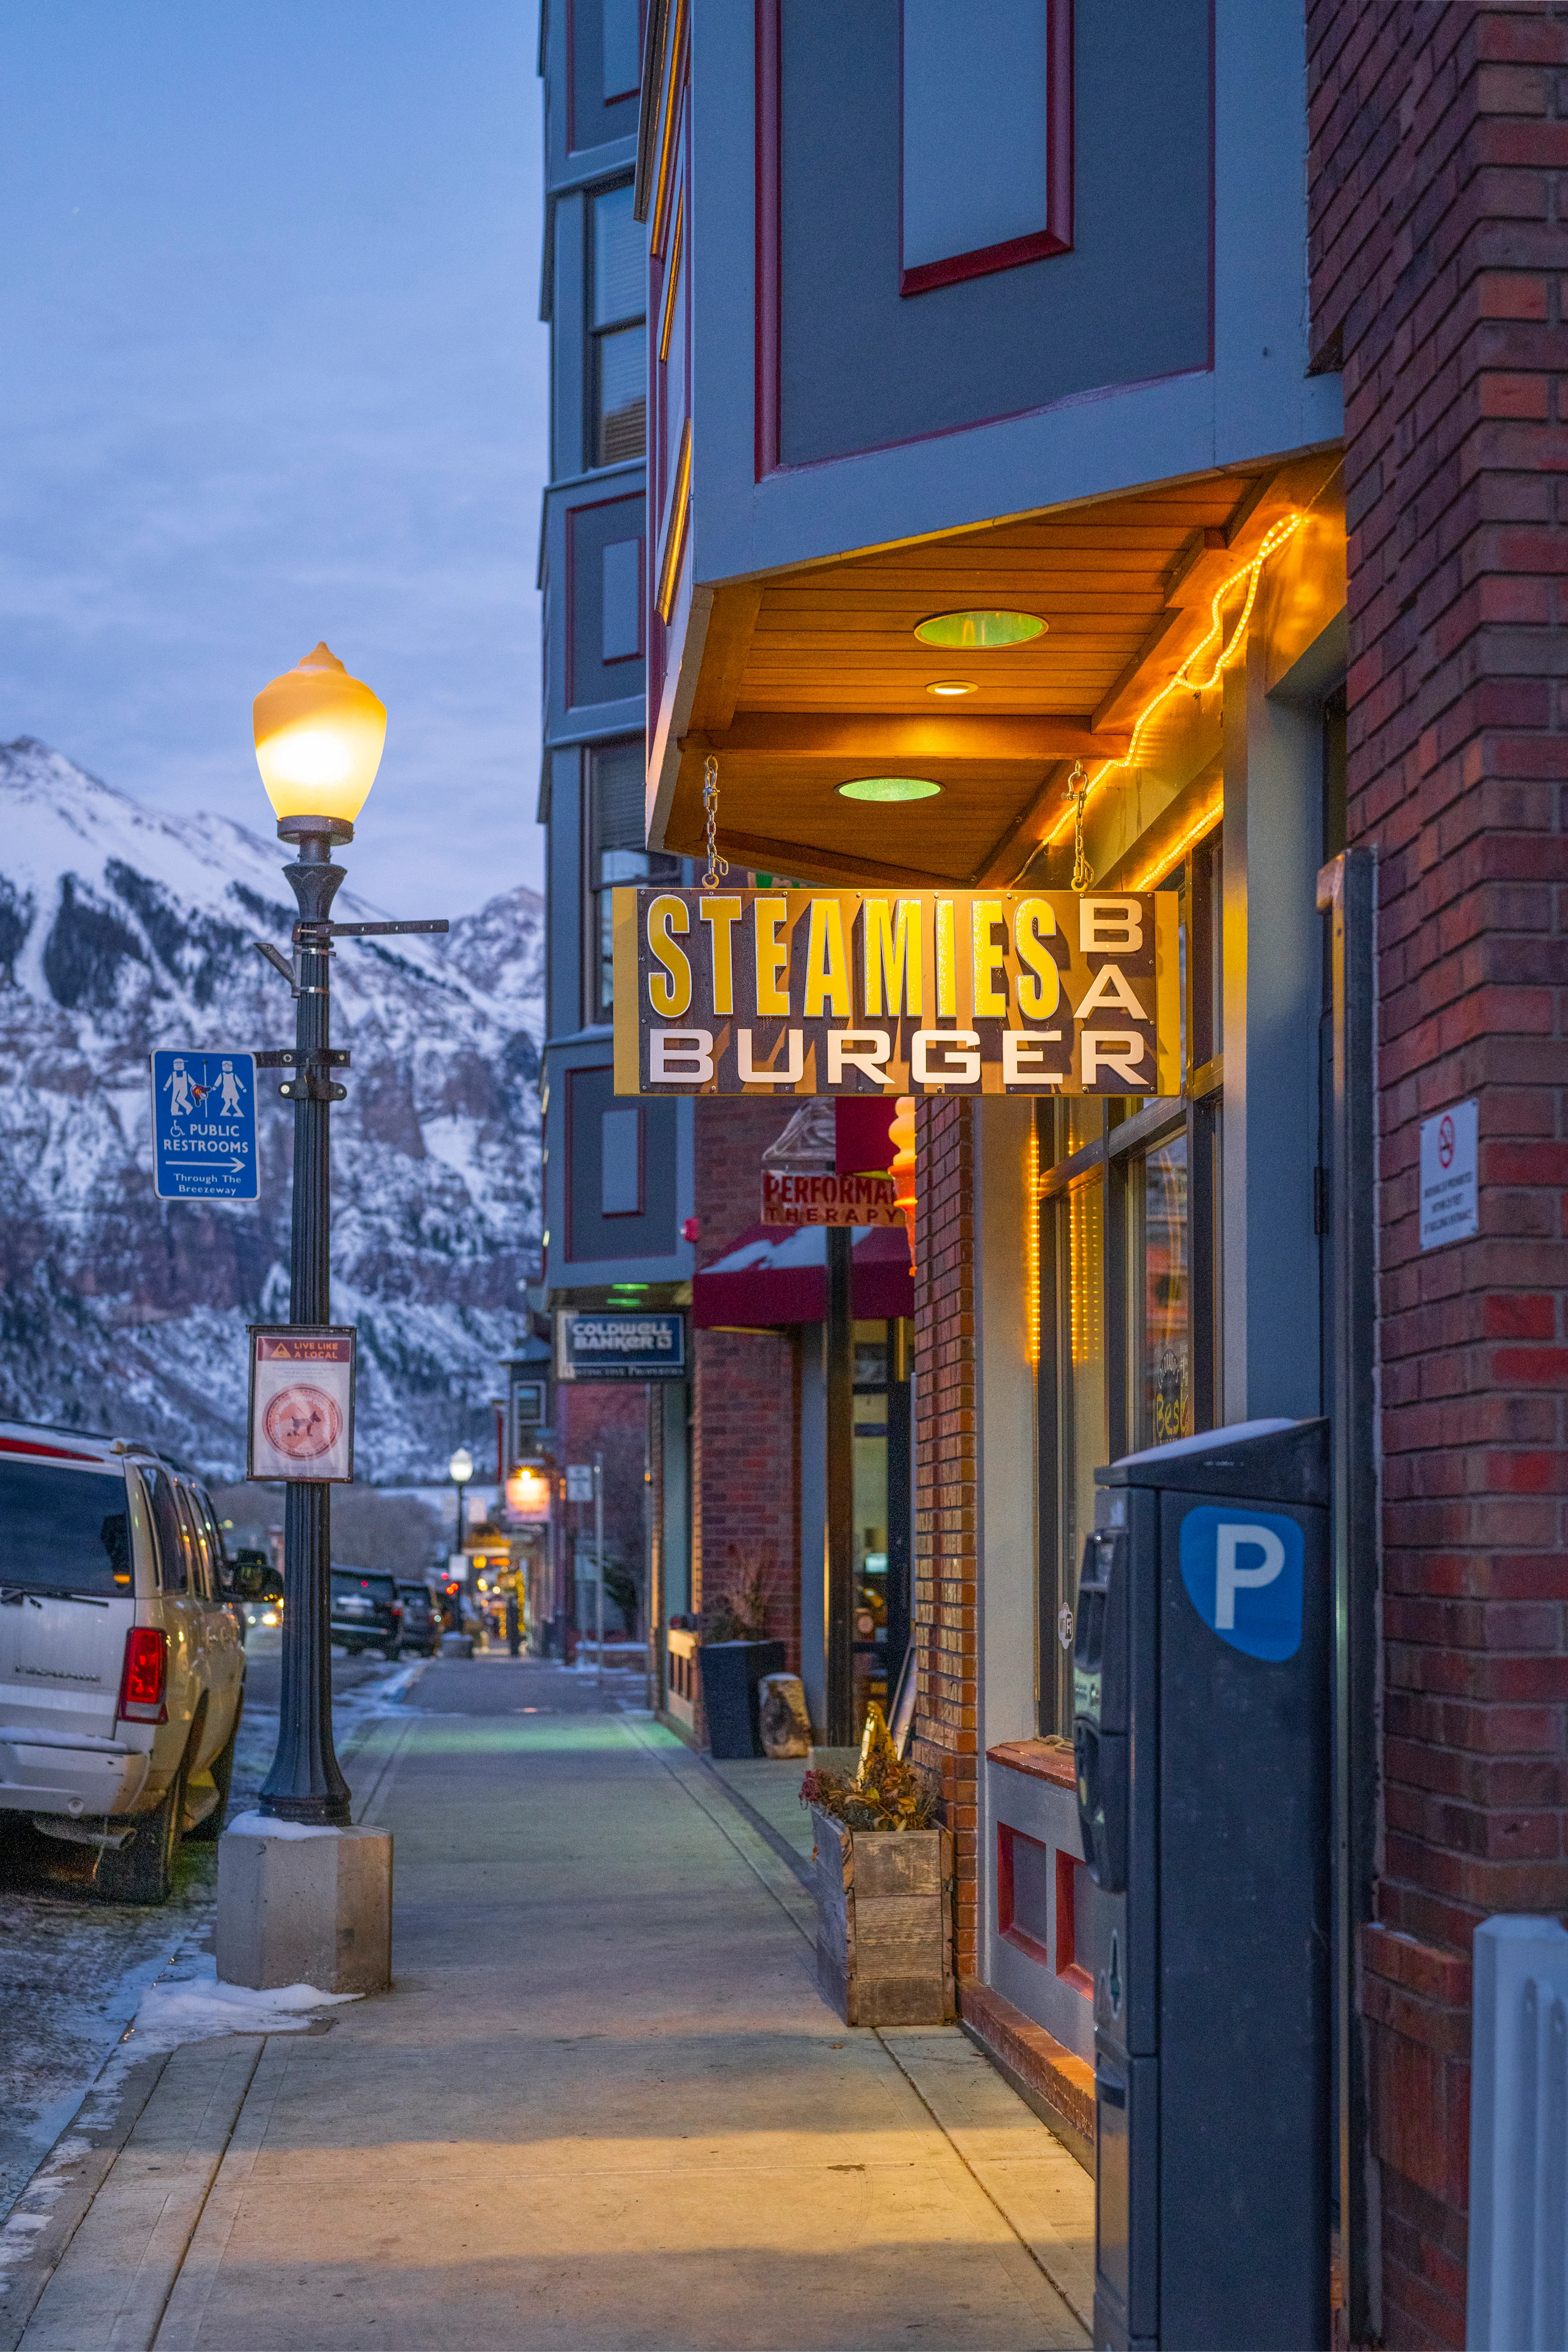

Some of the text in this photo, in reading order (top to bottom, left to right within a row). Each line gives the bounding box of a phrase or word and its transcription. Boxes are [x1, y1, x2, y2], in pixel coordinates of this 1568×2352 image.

[646, 894, 1061, 1021] STEAMIES
[650, 1029, 1149, 1085] BURGER
[190, 1124, 240, 1137] PUBLIC
[164, 1139, 248, 1153] RESTROOMS
[173, 1173, 242, 1184] Through The
[179, 1184, 236, 1196] Breezeway
[764, 1175, 896, 1204] PERFORMA
[765, 1208, 898, 1223] THERAPY
[1214, 1523, 1286, 1630] P
